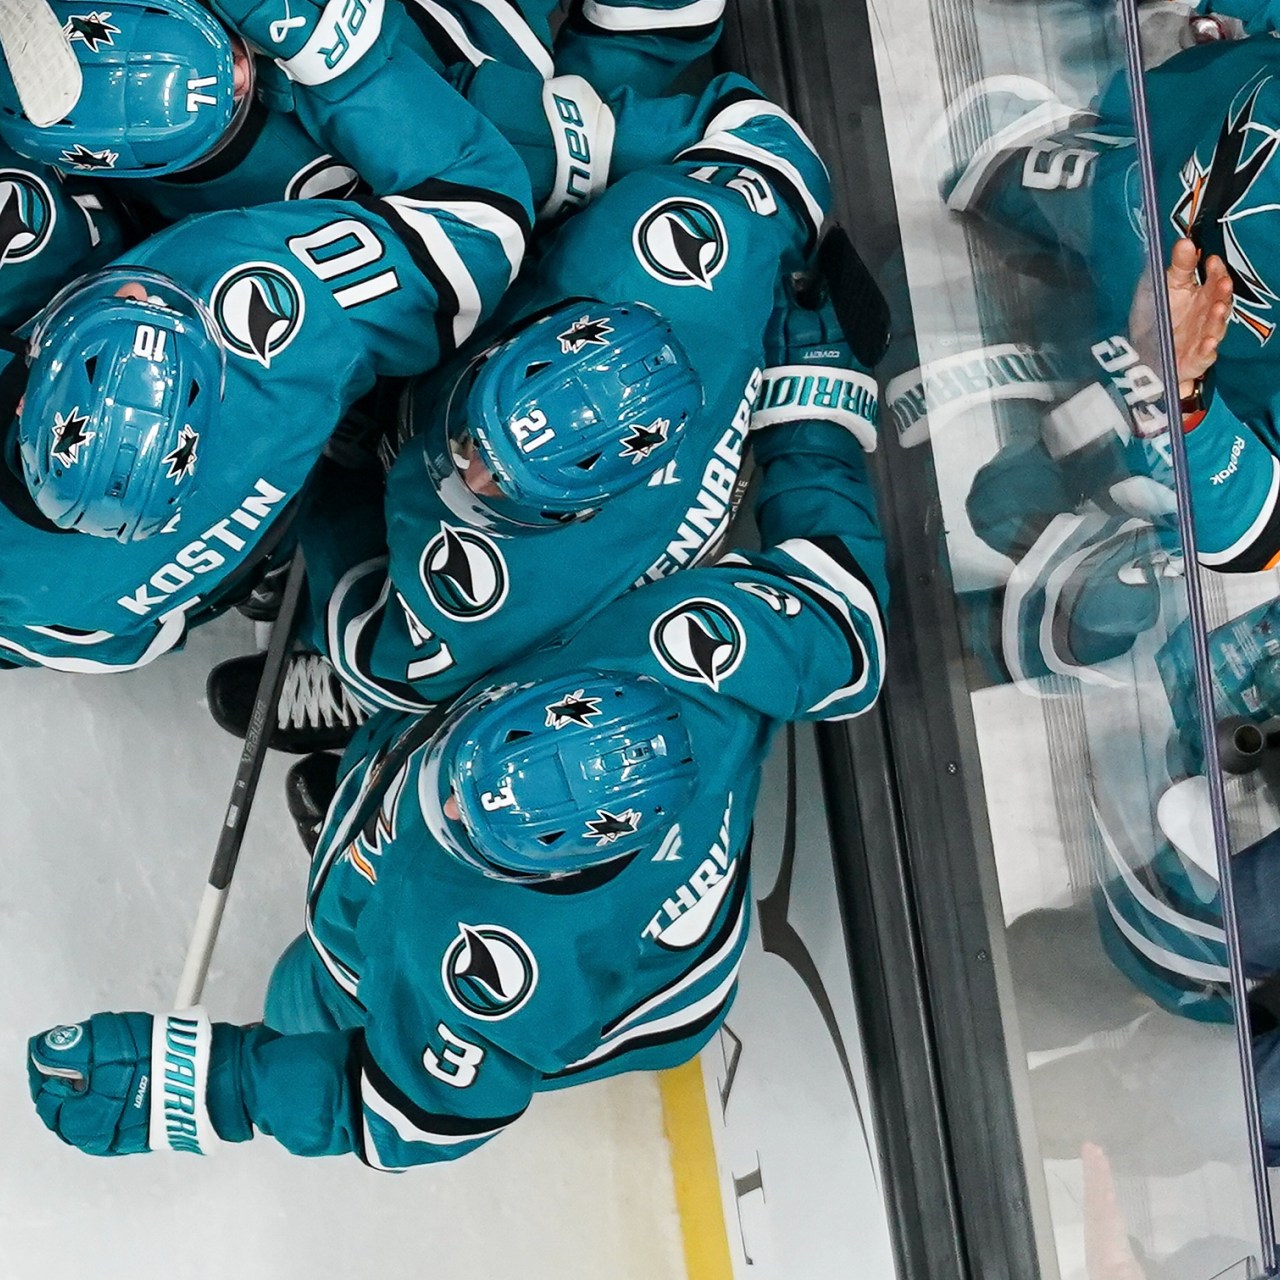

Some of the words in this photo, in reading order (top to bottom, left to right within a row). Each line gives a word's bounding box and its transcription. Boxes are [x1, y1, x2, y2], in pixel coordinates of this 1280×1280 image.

[186, 76, 218, 112] 71
[288, 218, 402, 311] 10
[132, 323, 168, 364] 10
[510, 408, 556, 454] 21
[1209, 435, 1246, 487] Reebok
[116, 477, 287, 616] KOSTIN
[481, 775, 521, 812] 3
[422, 1022, 484, 1088] 3
